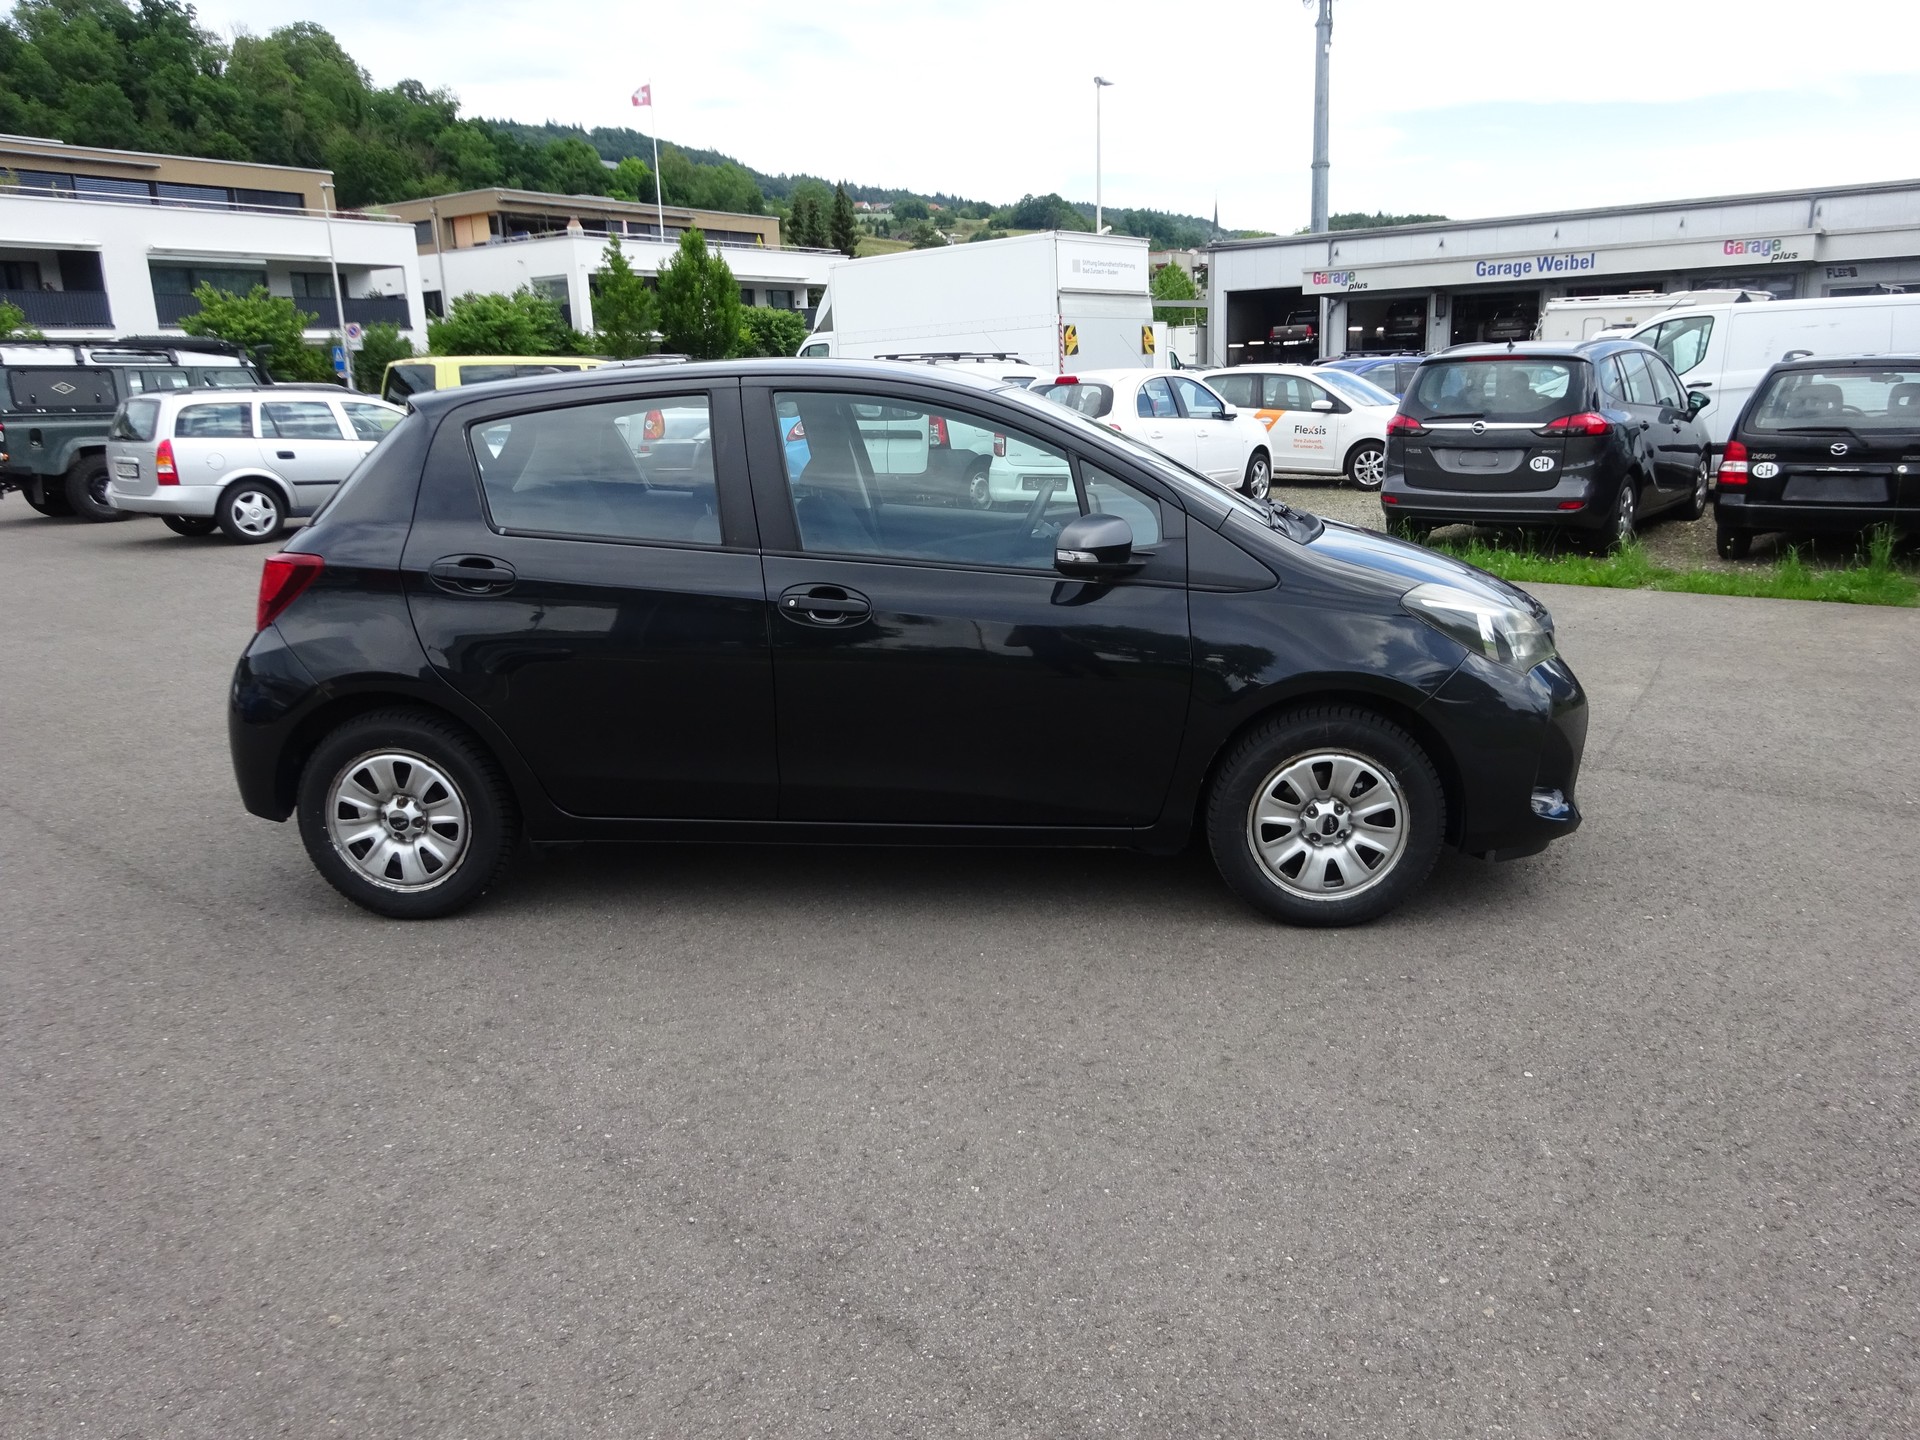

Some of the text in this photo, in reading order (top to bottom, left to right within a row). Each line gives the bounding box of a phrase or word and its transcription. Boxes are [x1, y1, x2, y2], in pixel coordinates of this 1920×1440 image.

[1723, 239, 1782, 257] Garage
[1771, 251, 1798, 263] plus
[1476, 253, 1595, 278] Garage Weibel
[1313, 271, 1356, 286] Garage
[1348, 282, 1368, 292] plus
[1294, 425, 1327, 435] Flexsis
[1533, 458, 1549, 470] CH
[1756, 464, 1774, 476] CH
